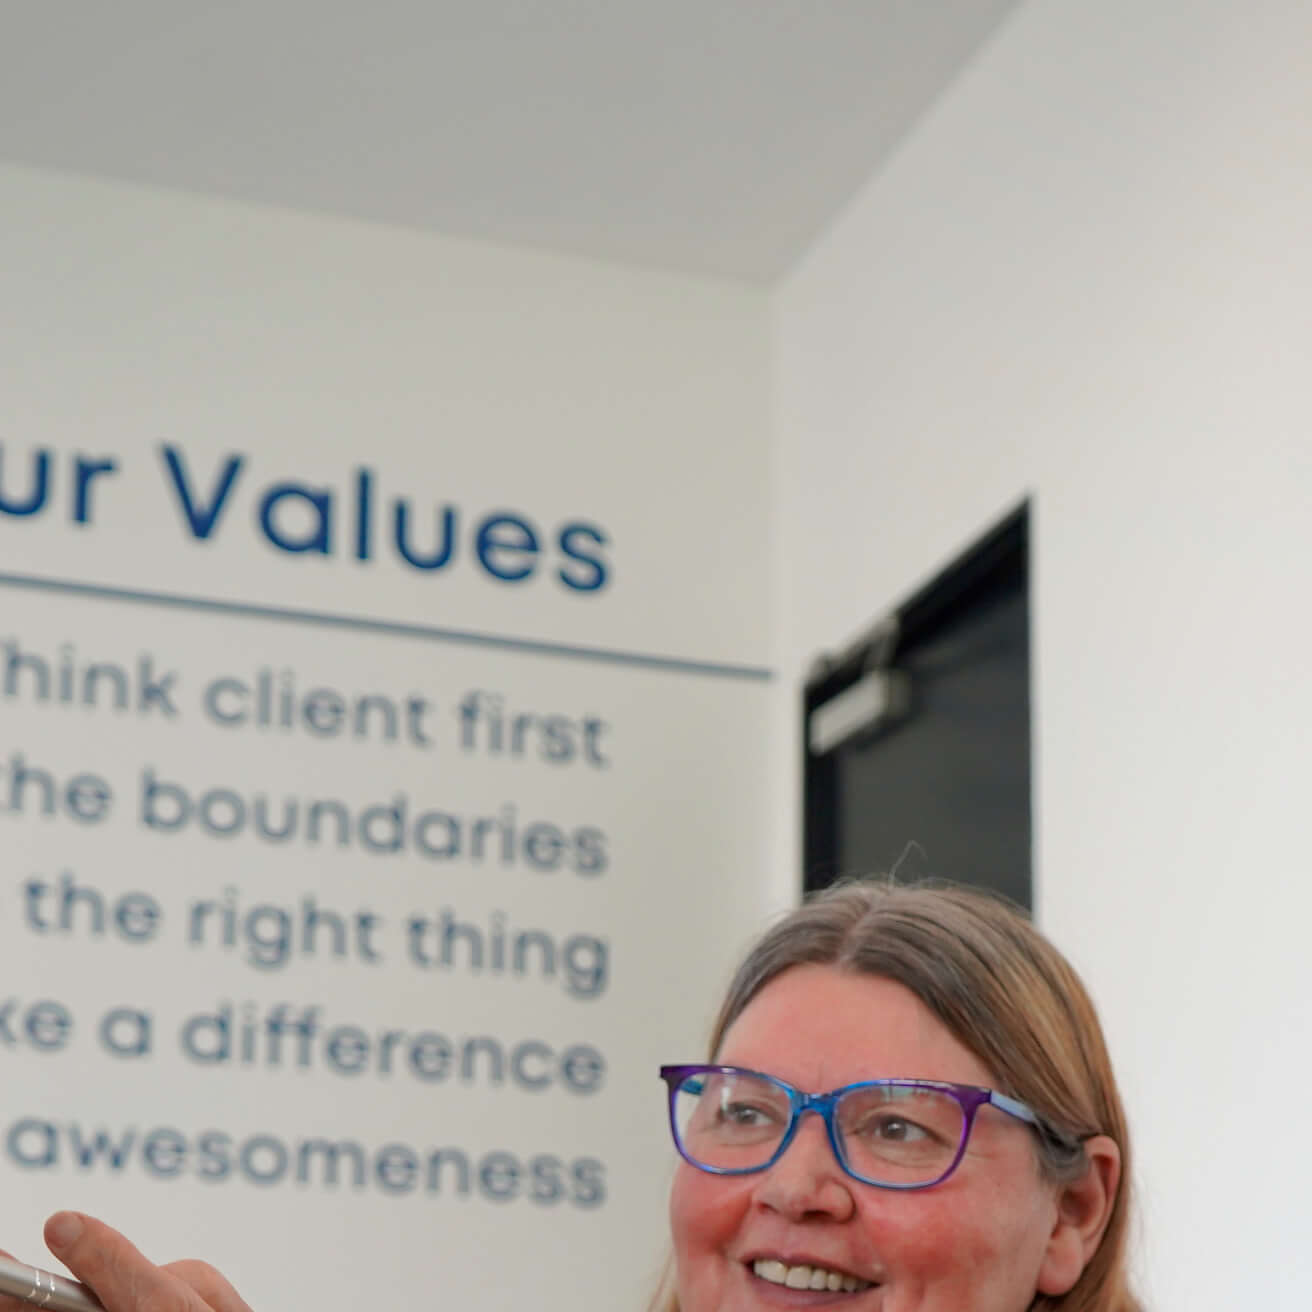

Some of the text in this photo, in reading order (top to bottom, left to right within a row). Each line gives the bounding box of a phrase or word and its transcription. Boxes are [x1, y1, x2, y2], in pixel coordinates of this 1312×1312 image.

[158, 440, 613, 595] Values
[203, 668, 432, 749] client
[457, 691, 610, 768] first
[137, 765, 610, 878] boundaries
[21, 868, 163, 943] the
[189, 887, 382, 972] right
[405, 906, 612, 1000] thing
[99, 1006, 153, 1060] a
[179, 999, 607, 1097] difference
[4, 1115, 607, 1210] awesomeness
